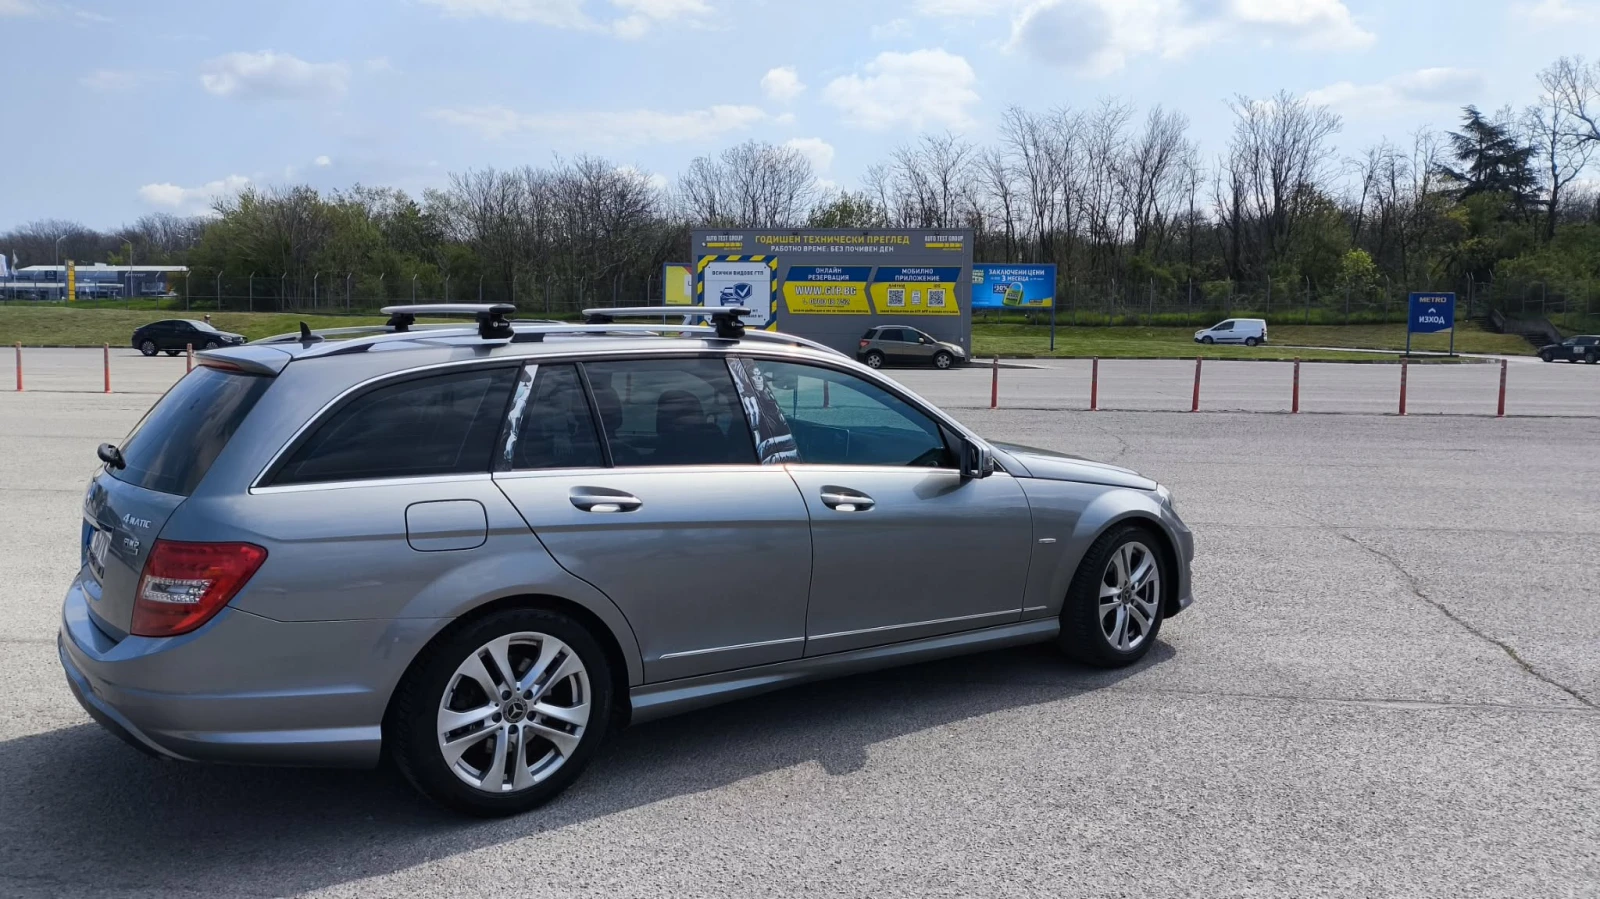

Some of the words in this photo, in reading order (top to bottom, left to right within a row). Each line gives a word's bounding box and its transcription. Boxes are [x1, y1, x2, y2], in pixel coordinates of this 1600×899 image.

[755, 235, 801, 244] ГОДИШЕН
[803, 235, 865, 244] ТЕХНИЧЕСКИ
[867, 235, 910, 245] ПРЕГЛЕД
[988, 268, 1027, 276] ЗАКЛЮЧЕНИ
[1028, 269, 1045, 277] ЦЕНИ
[1418, 315, 1446, 325] ИЗХОД
